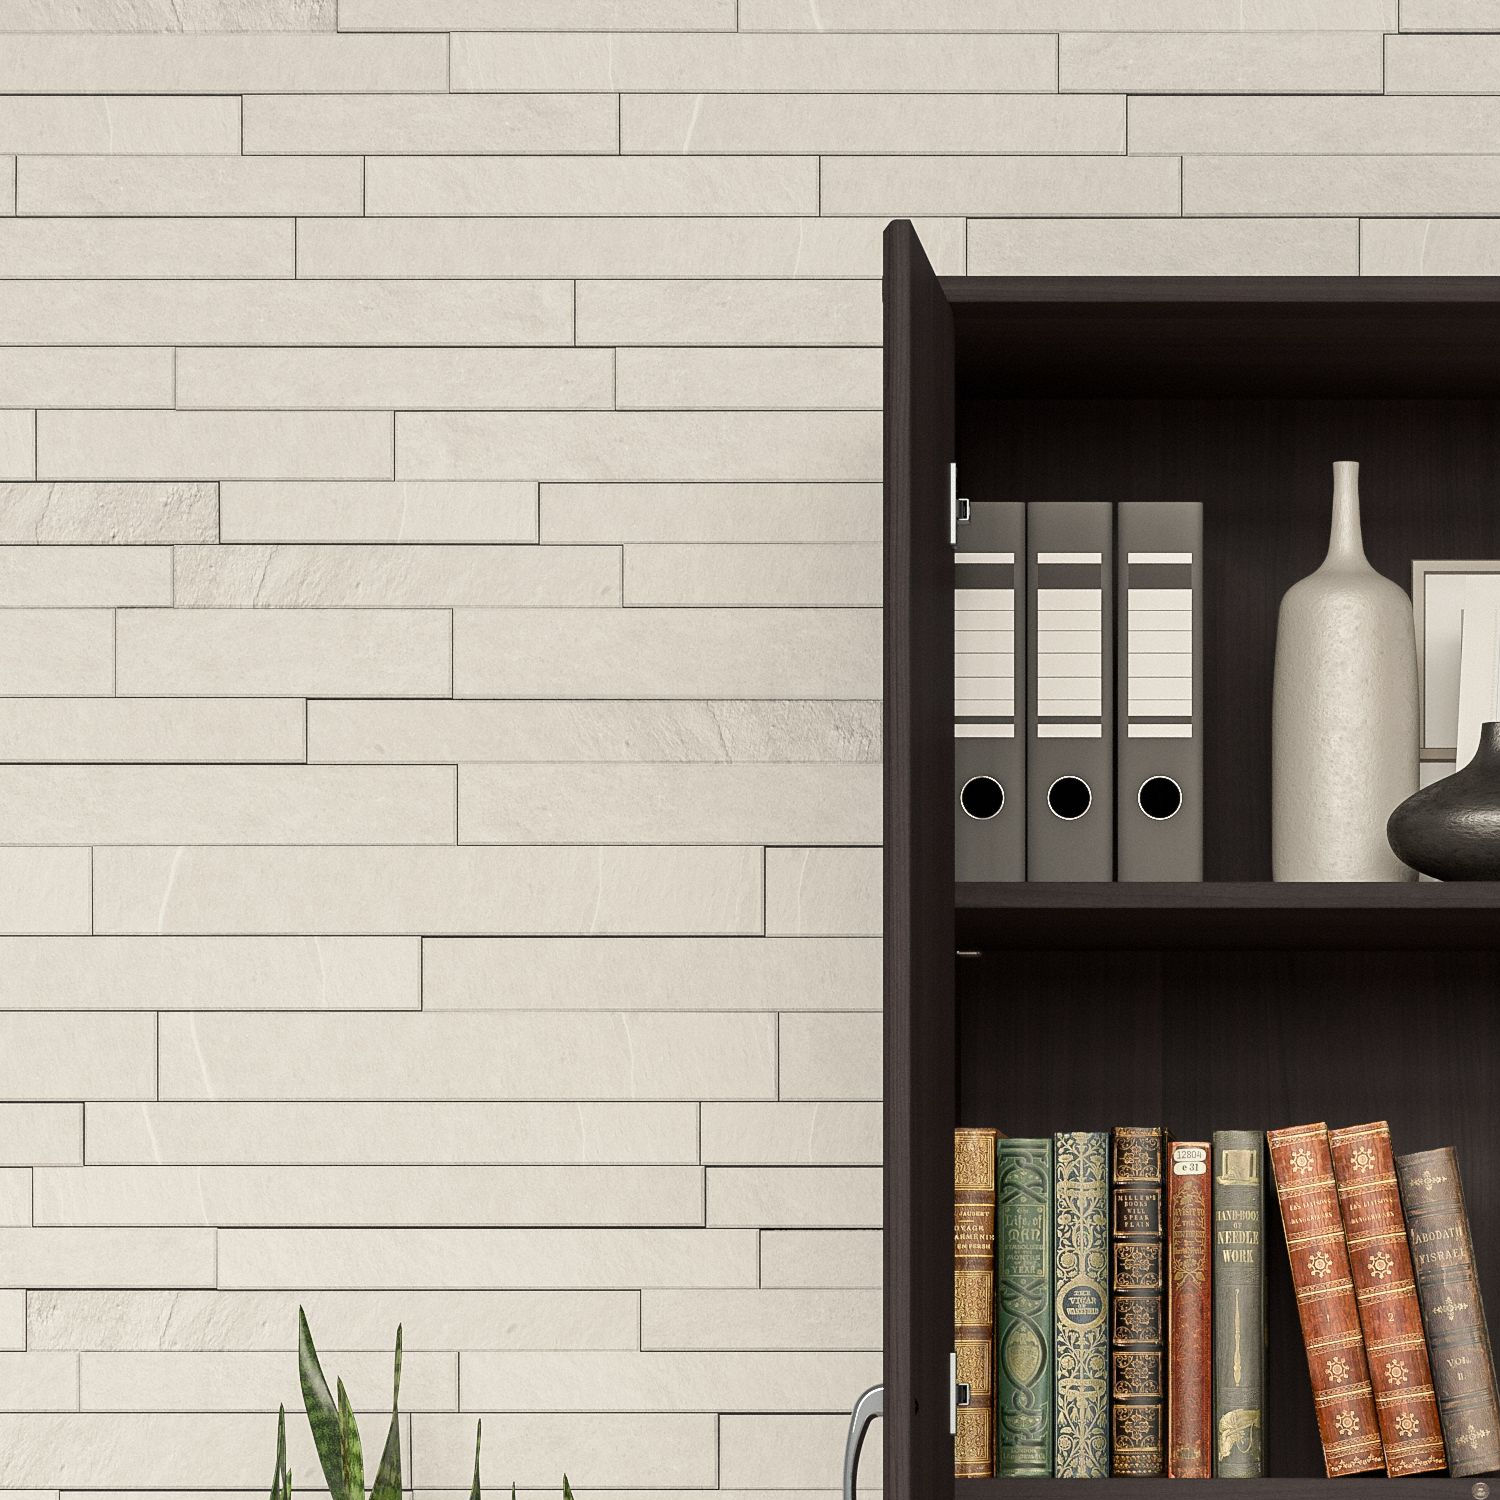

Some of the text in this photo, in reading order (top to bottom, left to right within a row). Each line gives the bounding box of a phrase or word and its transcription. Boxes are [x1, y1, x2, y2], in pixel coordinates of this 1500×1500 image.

[1176, 1150, 1202, 1160] 12804
[1189, 1162, 1199, 1172] 31
[1217, 1230, 1260, 1245] NEEDLE
[1222, 1249, 1254, 1263] WORK
[1418, 1248, 1465, 1265] YISRAEL
[1387, 1312, 1395, 1322] 2
